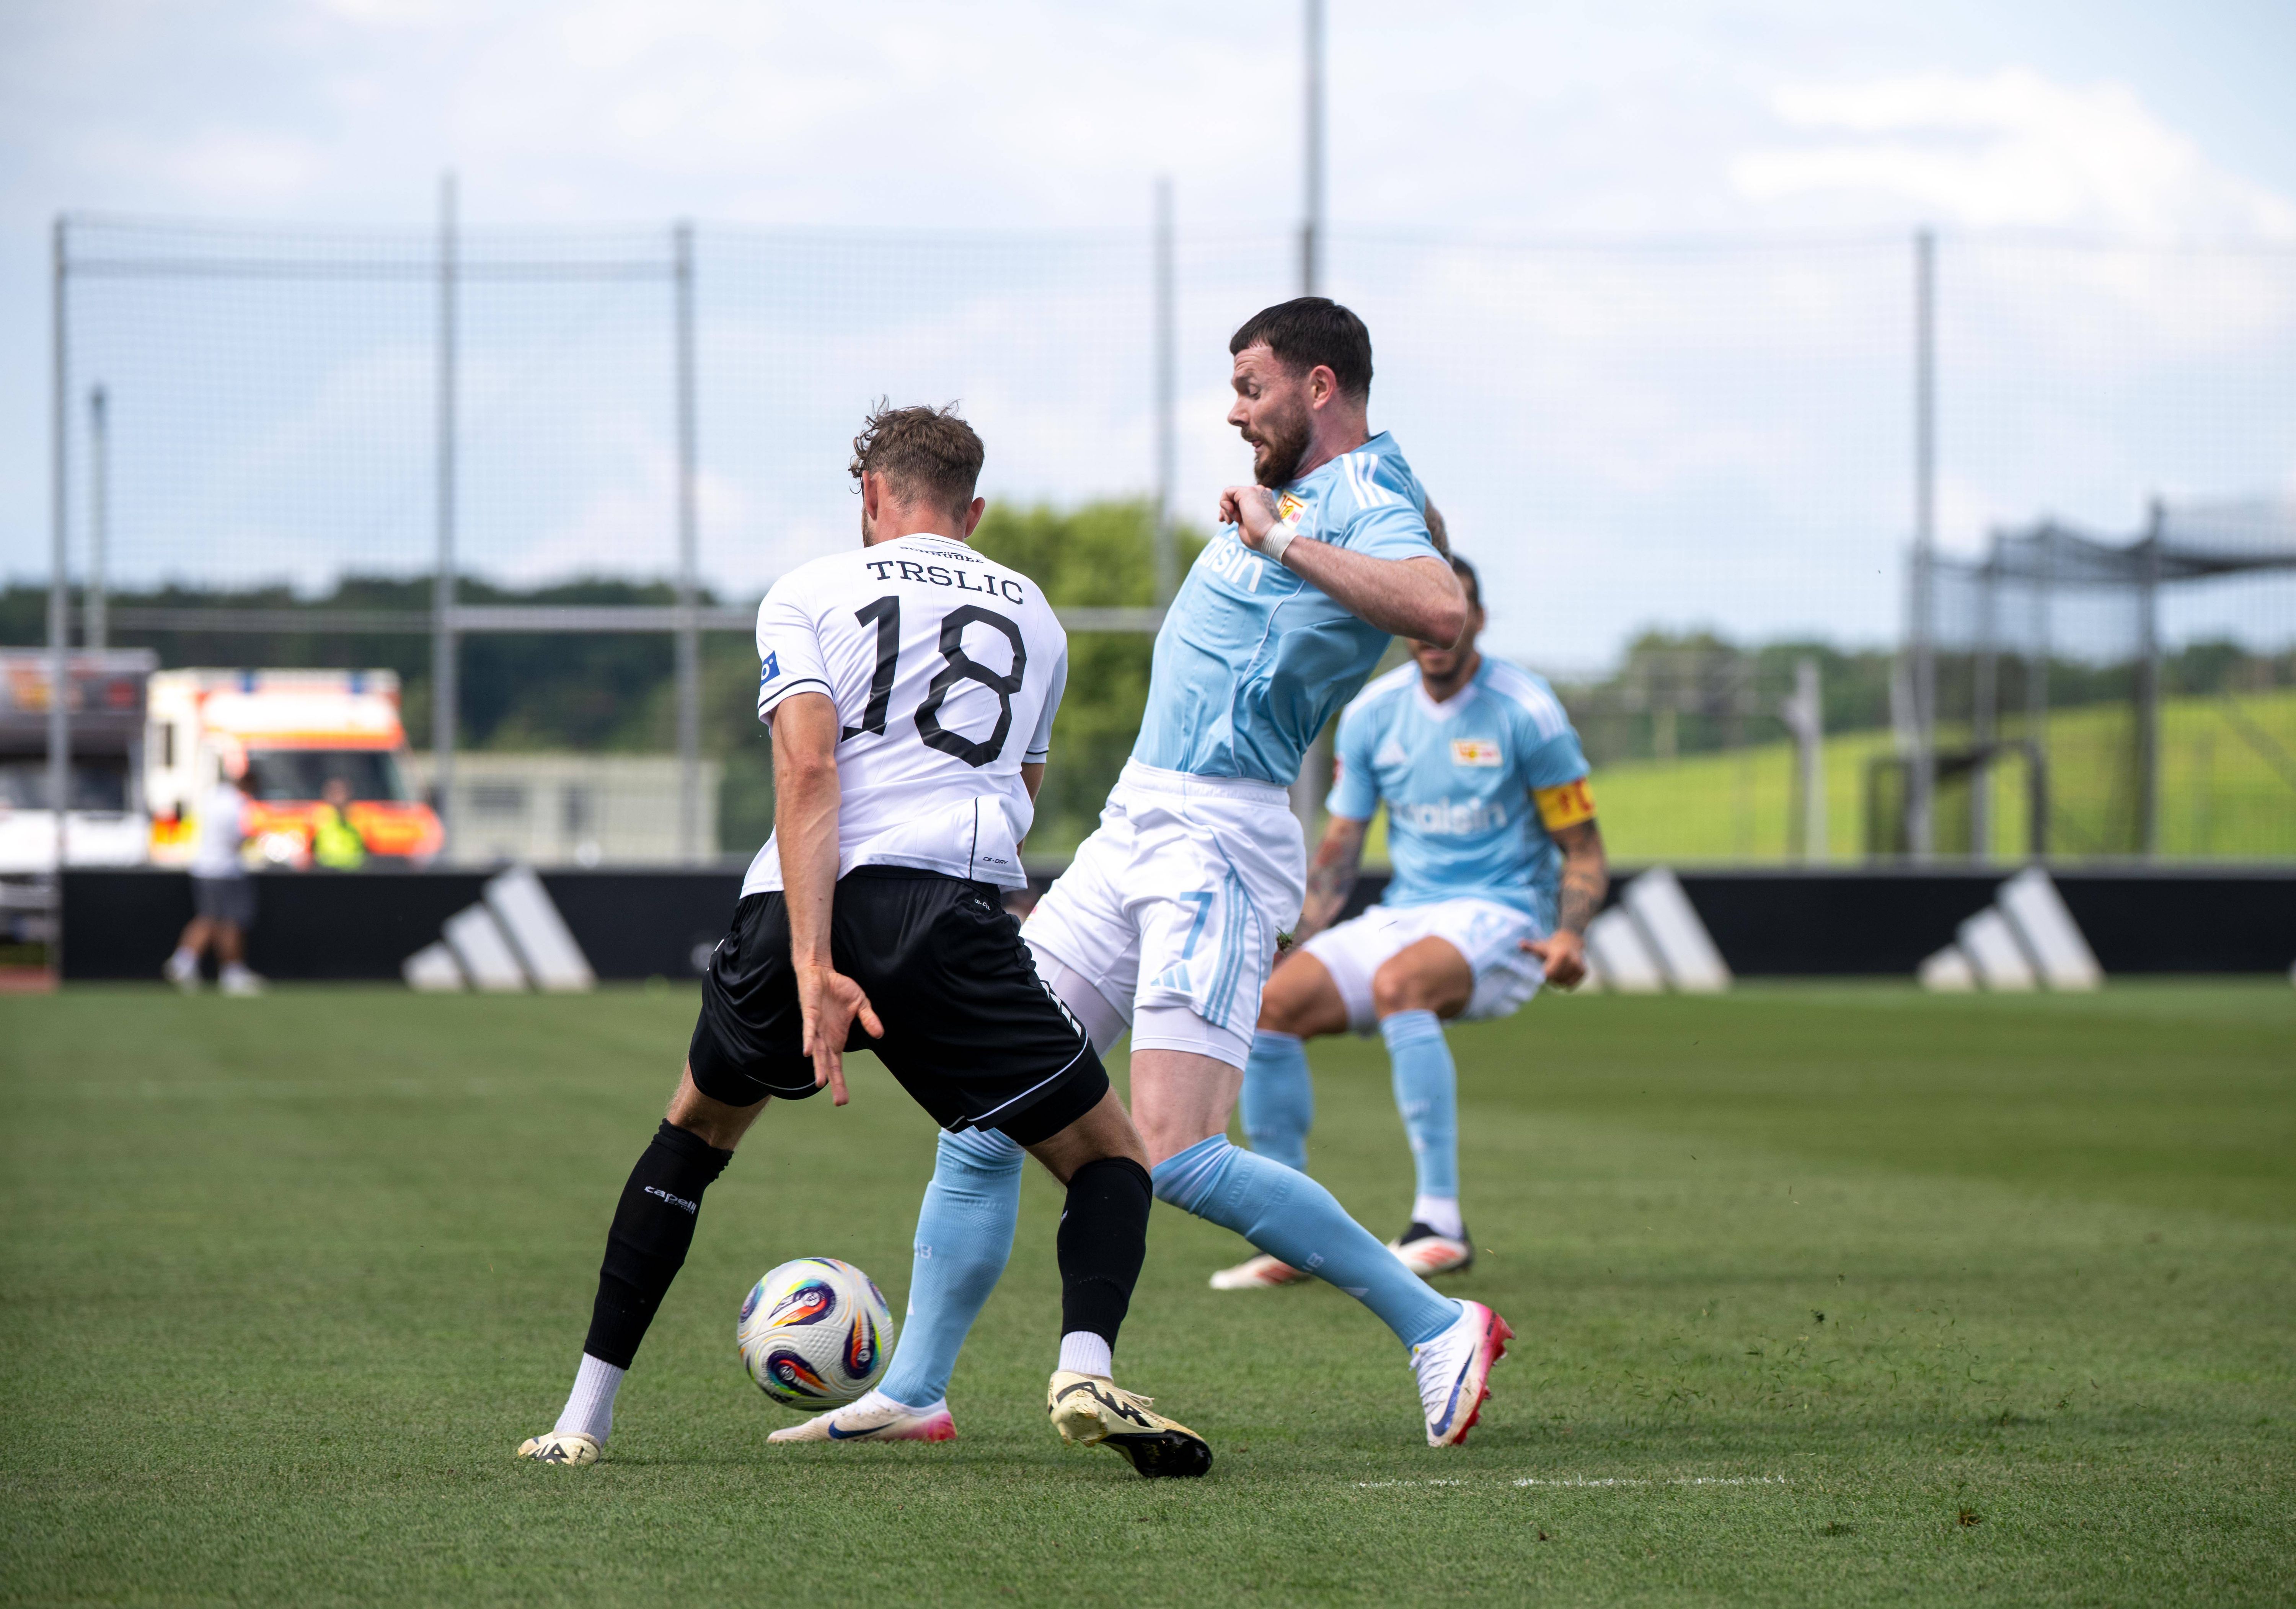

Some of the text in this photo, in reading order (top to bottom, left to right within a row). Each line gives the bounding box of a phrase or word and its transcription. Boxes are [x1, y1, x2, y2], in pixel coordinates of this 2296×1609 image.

[866, 560, 1024, 605] TRSLIC
[1199, 530, 1263, 593] aisin
[841, 595, 1027, 768] 18
[1179, 891, 1213, 961] 7
[644, 1186, 697, 1211] capelli
